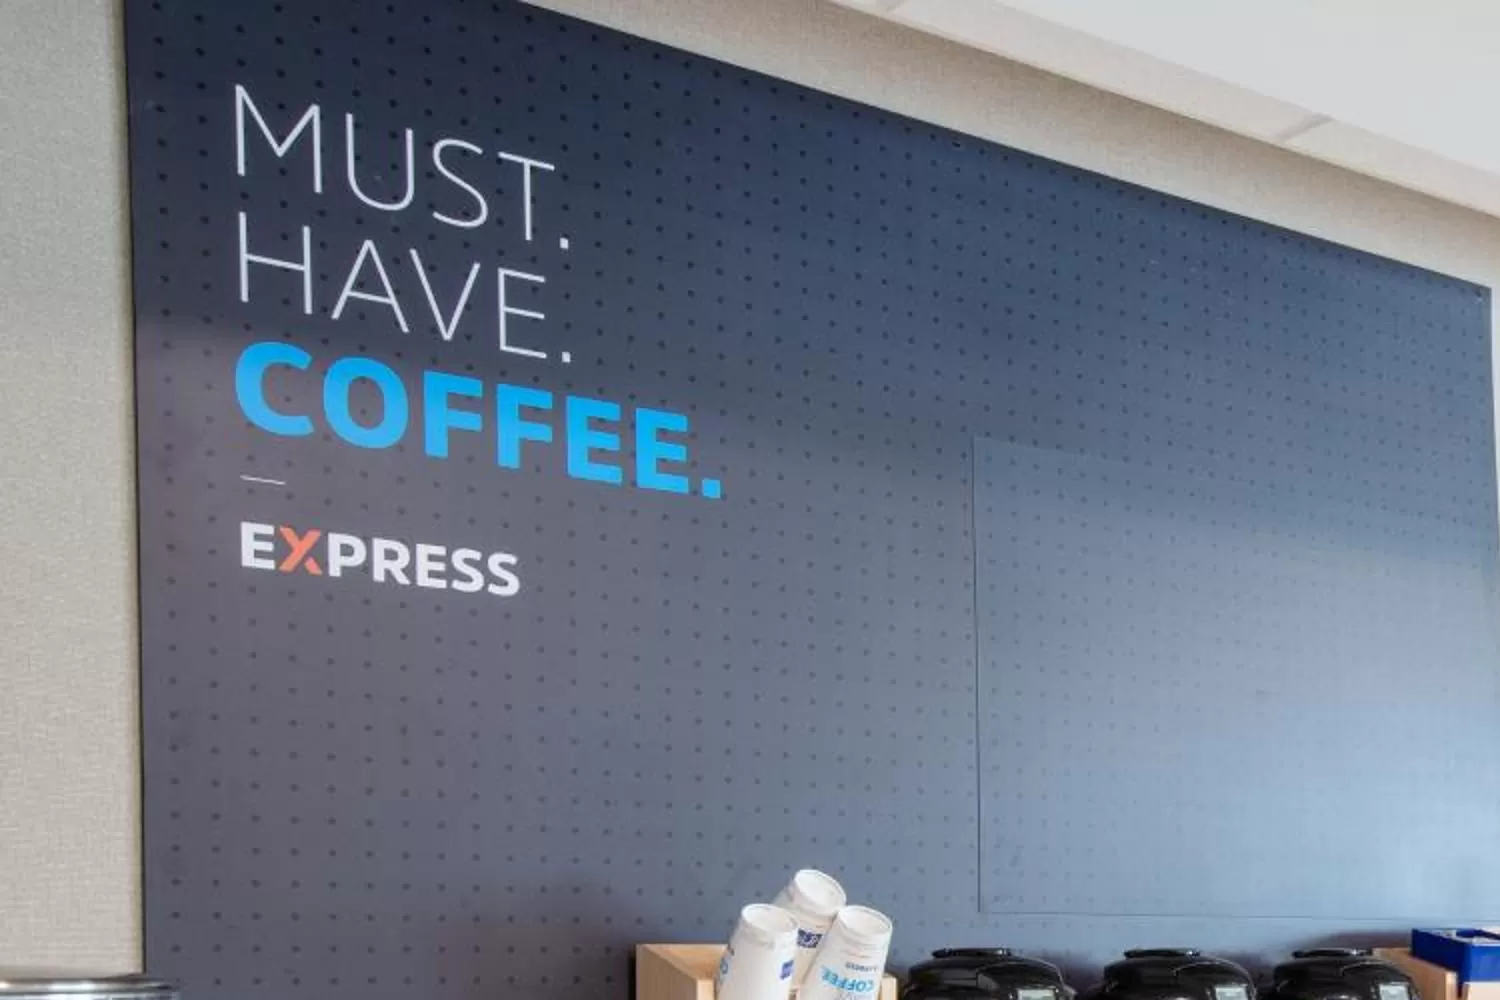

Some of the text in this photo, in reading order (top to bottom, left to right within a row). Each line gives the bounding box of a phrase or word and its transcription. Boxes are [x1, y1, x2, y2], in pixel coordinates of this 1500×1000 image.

[235, 84, 569, 250] MUST.
[238, 211, 572, 363] HAVE.
[235, 341, 721, 499] COFFEE.
[240, 521, 521, 597] EXPRESS
